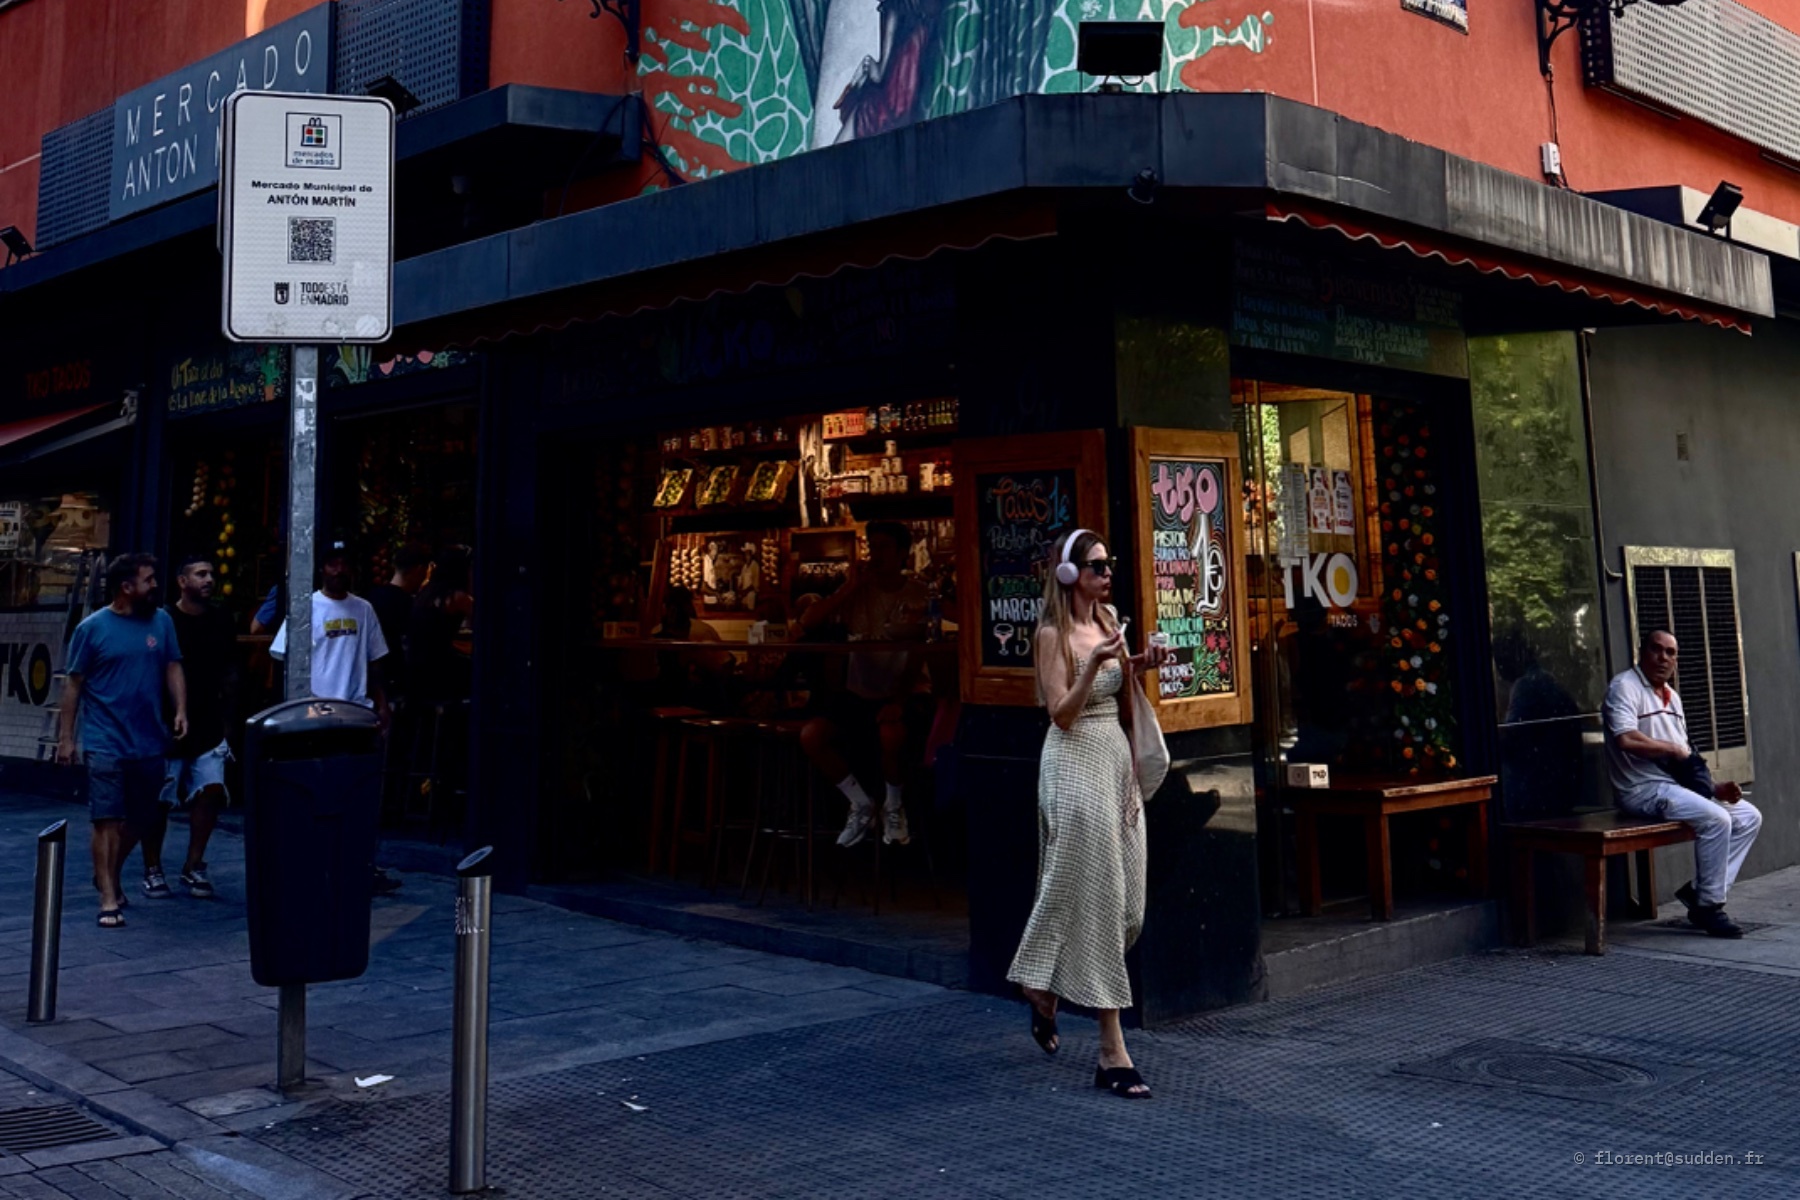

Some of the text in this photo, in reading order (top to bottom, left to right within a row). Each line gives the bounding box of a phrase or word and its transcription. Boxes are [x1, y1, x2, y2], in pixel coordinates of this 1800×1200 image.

[126, 30, 312, 147] MERCADO
[251, 180, 373, 193] Mercado Municipal de
[267, 193, 356, 207] ANTÓN MARTÍN
[1152, 464, 1218, 523] tko
[1153, 530, 1187, 547] PASTOR
[1280, 553, 1358, 609] TKO
[1157, 604, 1185, 619] POLLO
